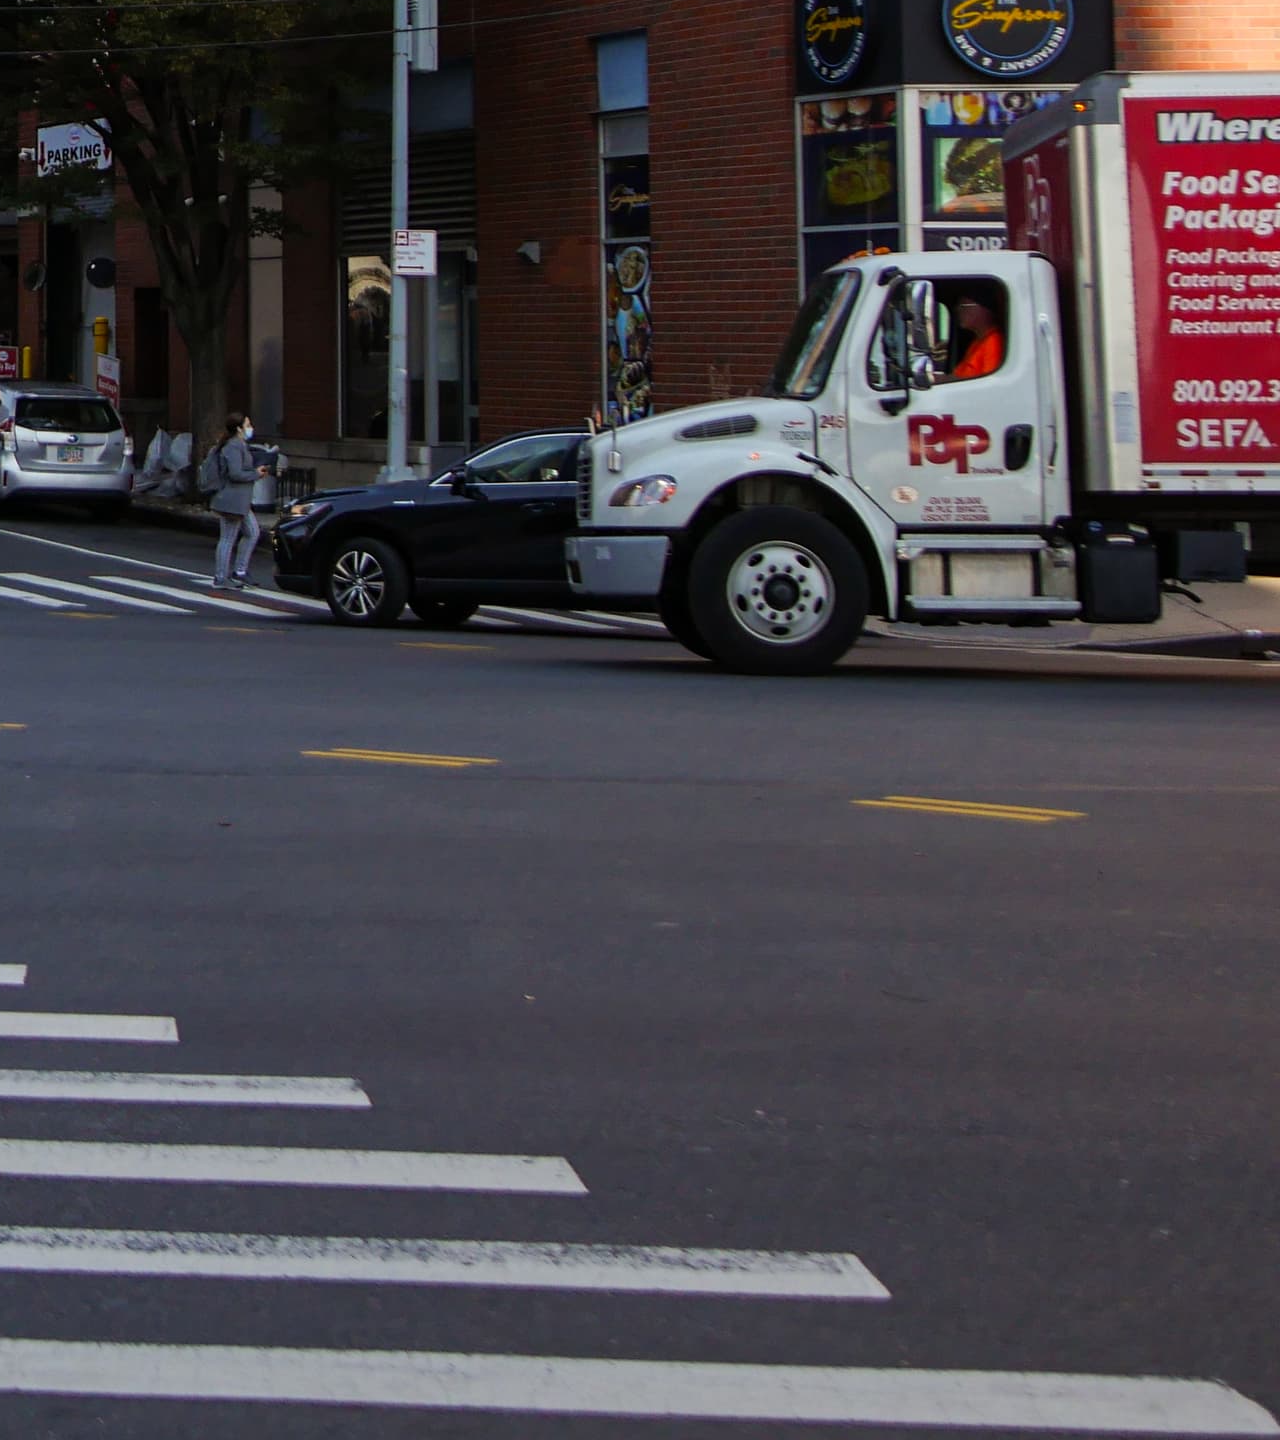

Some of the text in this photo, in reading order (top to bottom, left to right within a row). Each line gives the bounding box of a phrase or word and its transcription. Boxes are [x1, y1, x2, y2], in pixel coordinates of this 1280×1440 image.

[955, 35, 978, 57] BAR
[1156, 111, 1280, 142] Where
[47, 143, 101, 163] PARKING
[1162, 169, 1239, 196] Food
[1166, 248, 1213, 264] Food
[1168, 271, 1246, 291] Catering
[1169, 295, 1215, 311] Food
[1170, 318, 1274, 335] Restaurant
[1173, 379, 1280, 404] 800.992.3
[1177, 418, 1272, 448] SEFA
